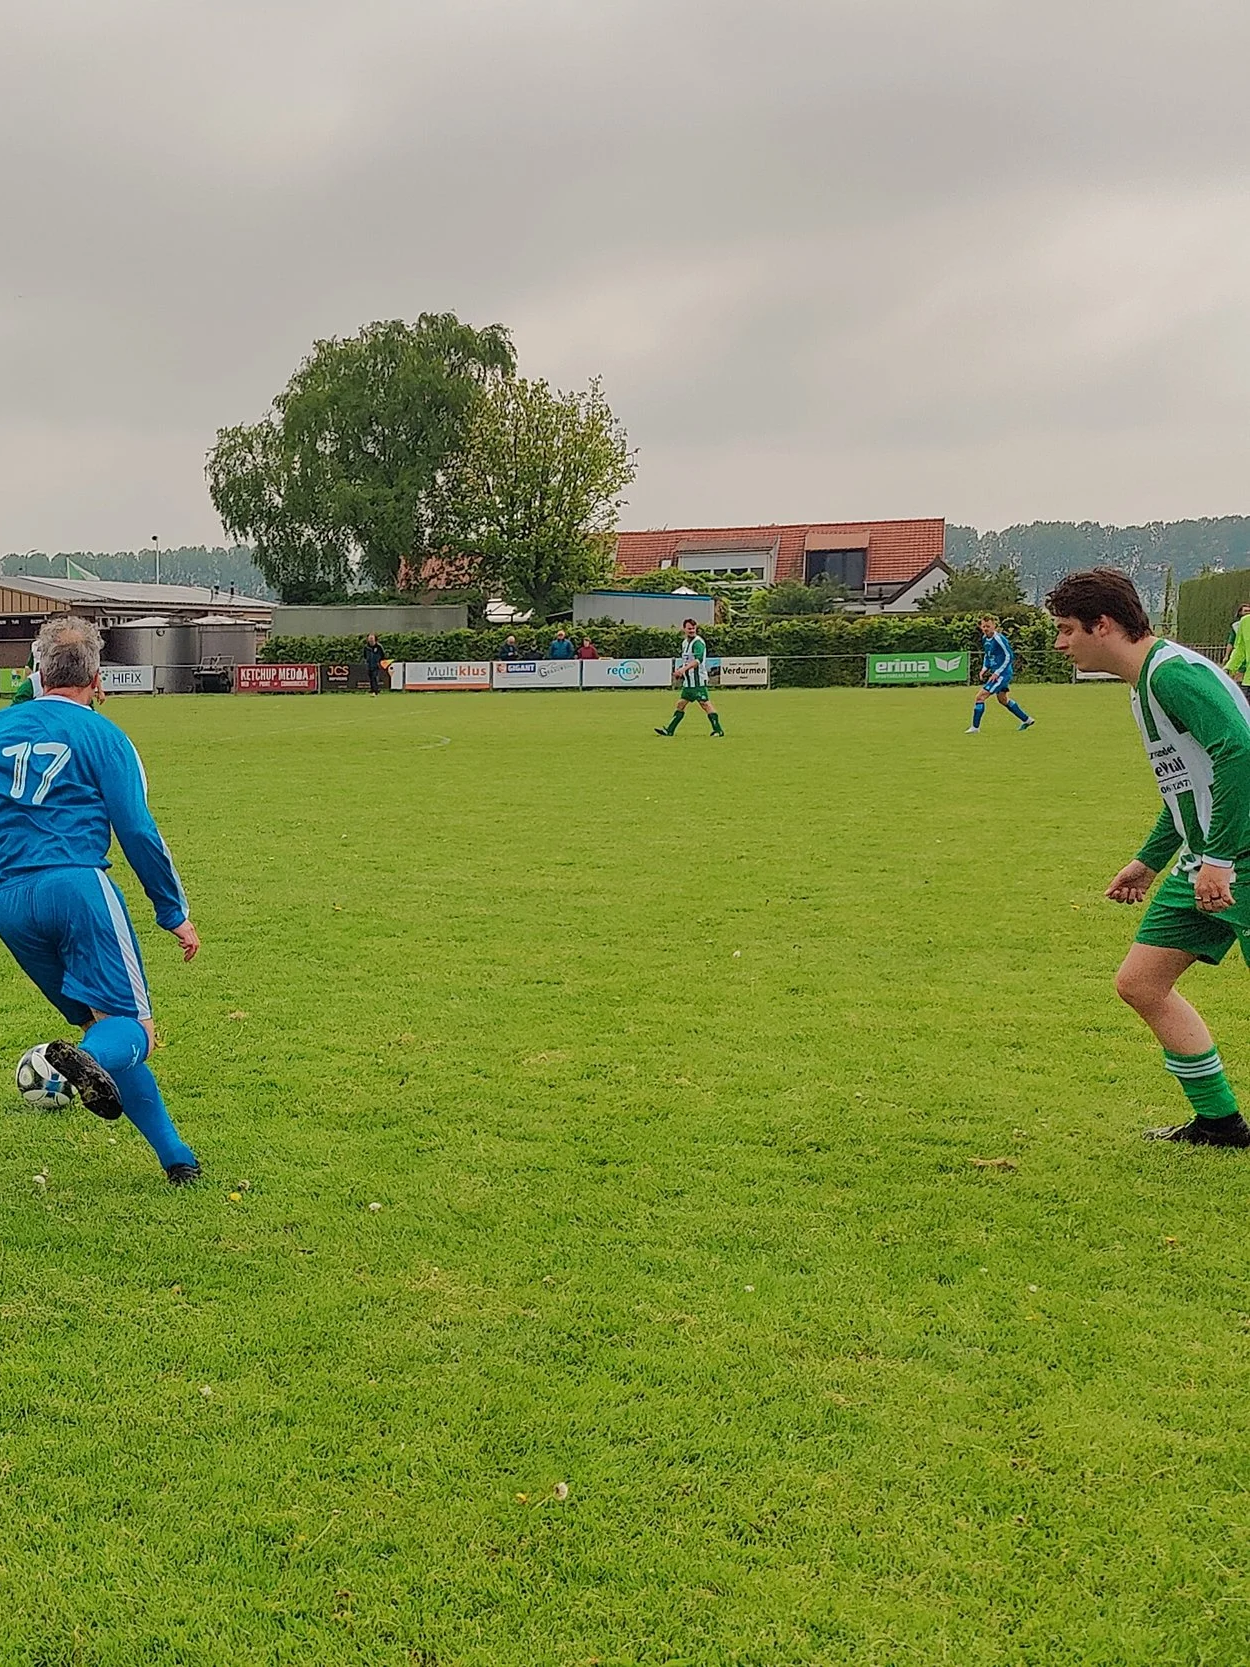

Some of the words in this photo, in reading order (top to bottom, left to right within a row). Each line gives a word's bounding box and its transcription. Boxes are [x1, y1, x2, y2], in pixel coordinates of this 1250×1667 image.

[327, 665, 349, 676] JCS
[427, 665, 487, 677] Multiklus
[507, 664, 535, 672] GIGANT
[607, 666, 645, 675] renewi
[722, 666, 767, 675] Verdurmen
[875, 658, 930, 673] erima
[112, 672, 142, 684] HIFIX
[240, 668, 277, 681] KETCHUP
[1, 741, 72, 806] 17
